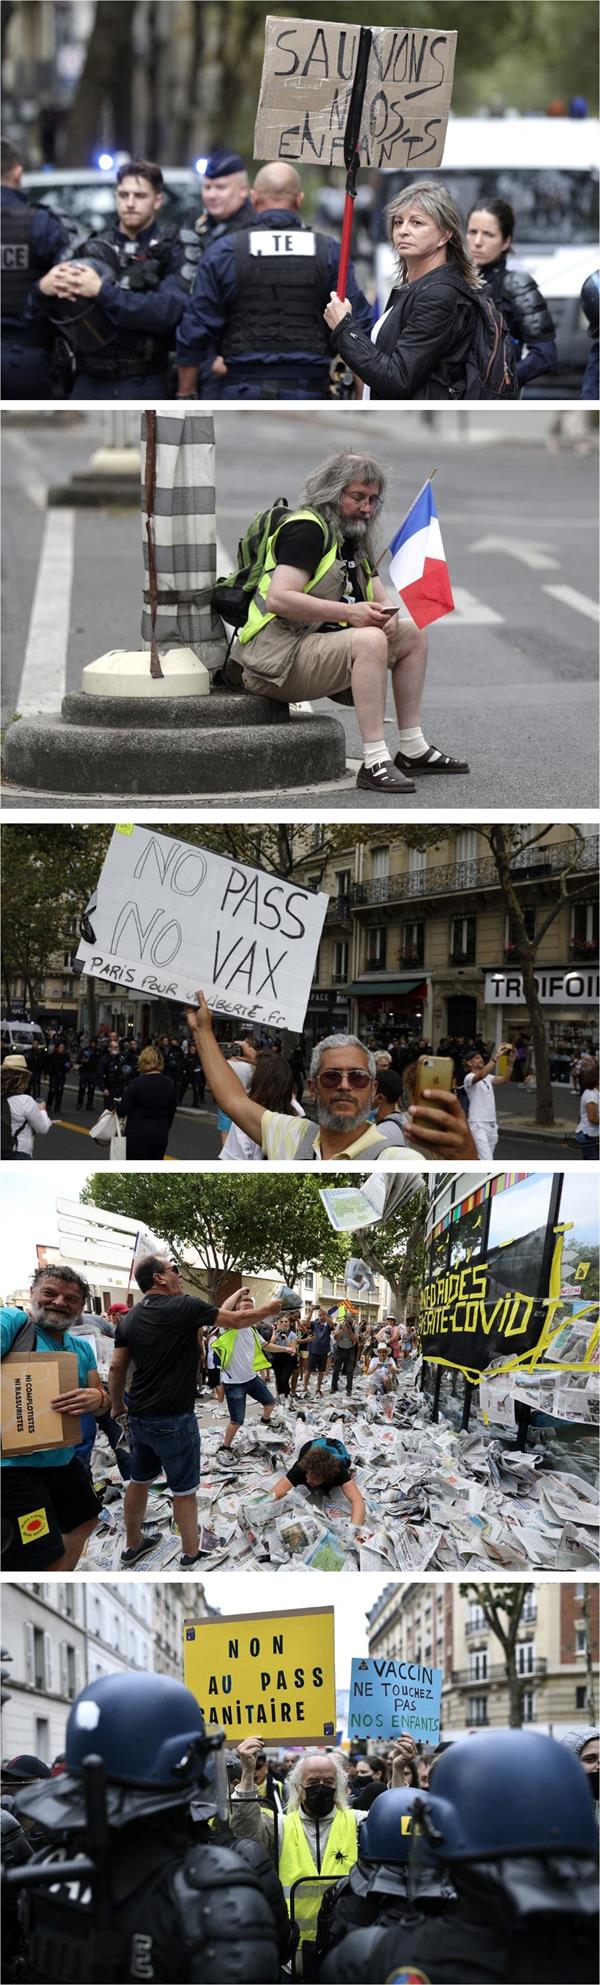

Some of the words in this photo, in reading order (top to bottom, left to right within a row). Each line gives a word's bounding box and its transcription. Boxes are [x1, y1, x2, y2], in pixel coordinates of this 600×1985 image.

[274, 28, 447, 101] SAUVONS
[329, 88, 406, 145] NOS
[278, 110, 441, 168] ENFANTS
[133, 836, 207, 896] NO
[220, 866, 309, 939] PASS
[110, 901, 182, 968] NO
[212, 930, 288, 999] VAX
[90, 957, 136, 983] PARIS
[491, 976, 599, 998] TRIFOI
[15, 1386, 24, 1432] RASSURISTES
[26, 1382, 35, 1434] COMPLOTISTES
[228, 1634, 284, 1659] NON
[208, 1674, 232, 1695] AU
[260, 1667, 323, 1691] PASS
[373, 1660, 433, 1685] VACCIN
[353, 1681, 373, 1697] NE
[381, 1682, 434, 1700] TOUCHEZ
[394, 1698, 416, 1712] PAS
[351, 1713, 383, 1728] NOS
[391, 1715, 439, 1732] ENFANTS
